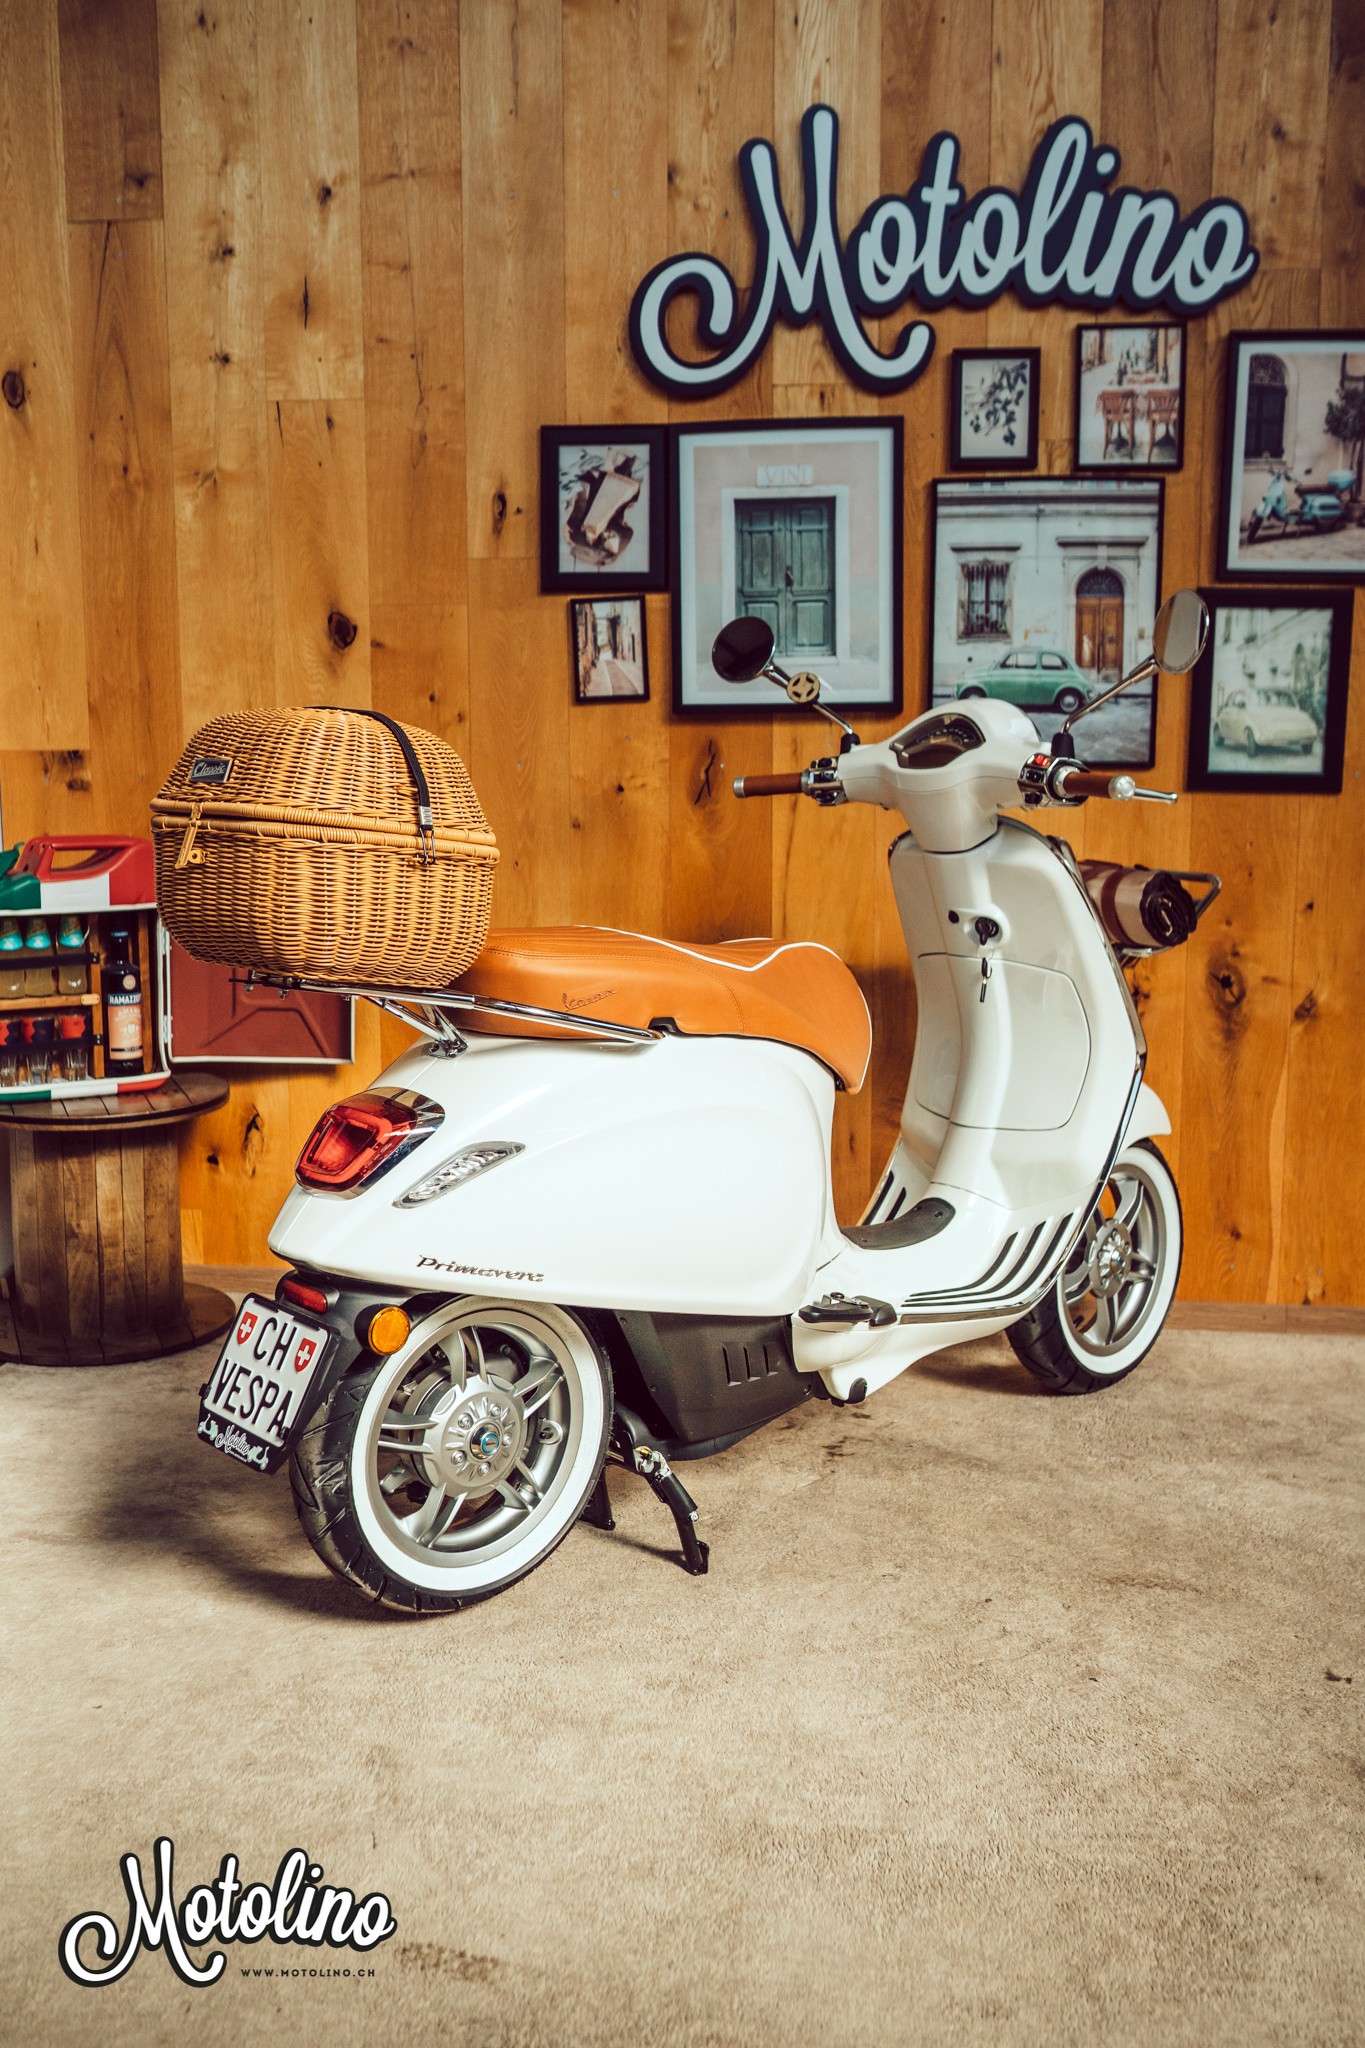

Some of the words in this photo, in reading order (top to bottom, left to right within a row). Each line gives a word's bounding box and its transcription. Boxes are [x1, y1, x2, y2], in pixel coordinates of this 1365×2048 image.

[634, 105, 1257, 390] Motolino
[192, 761, 226, 777] Classic
[253, 1316, 298, 1371] CH
[212, 1358, 294, 1438] VESPA
